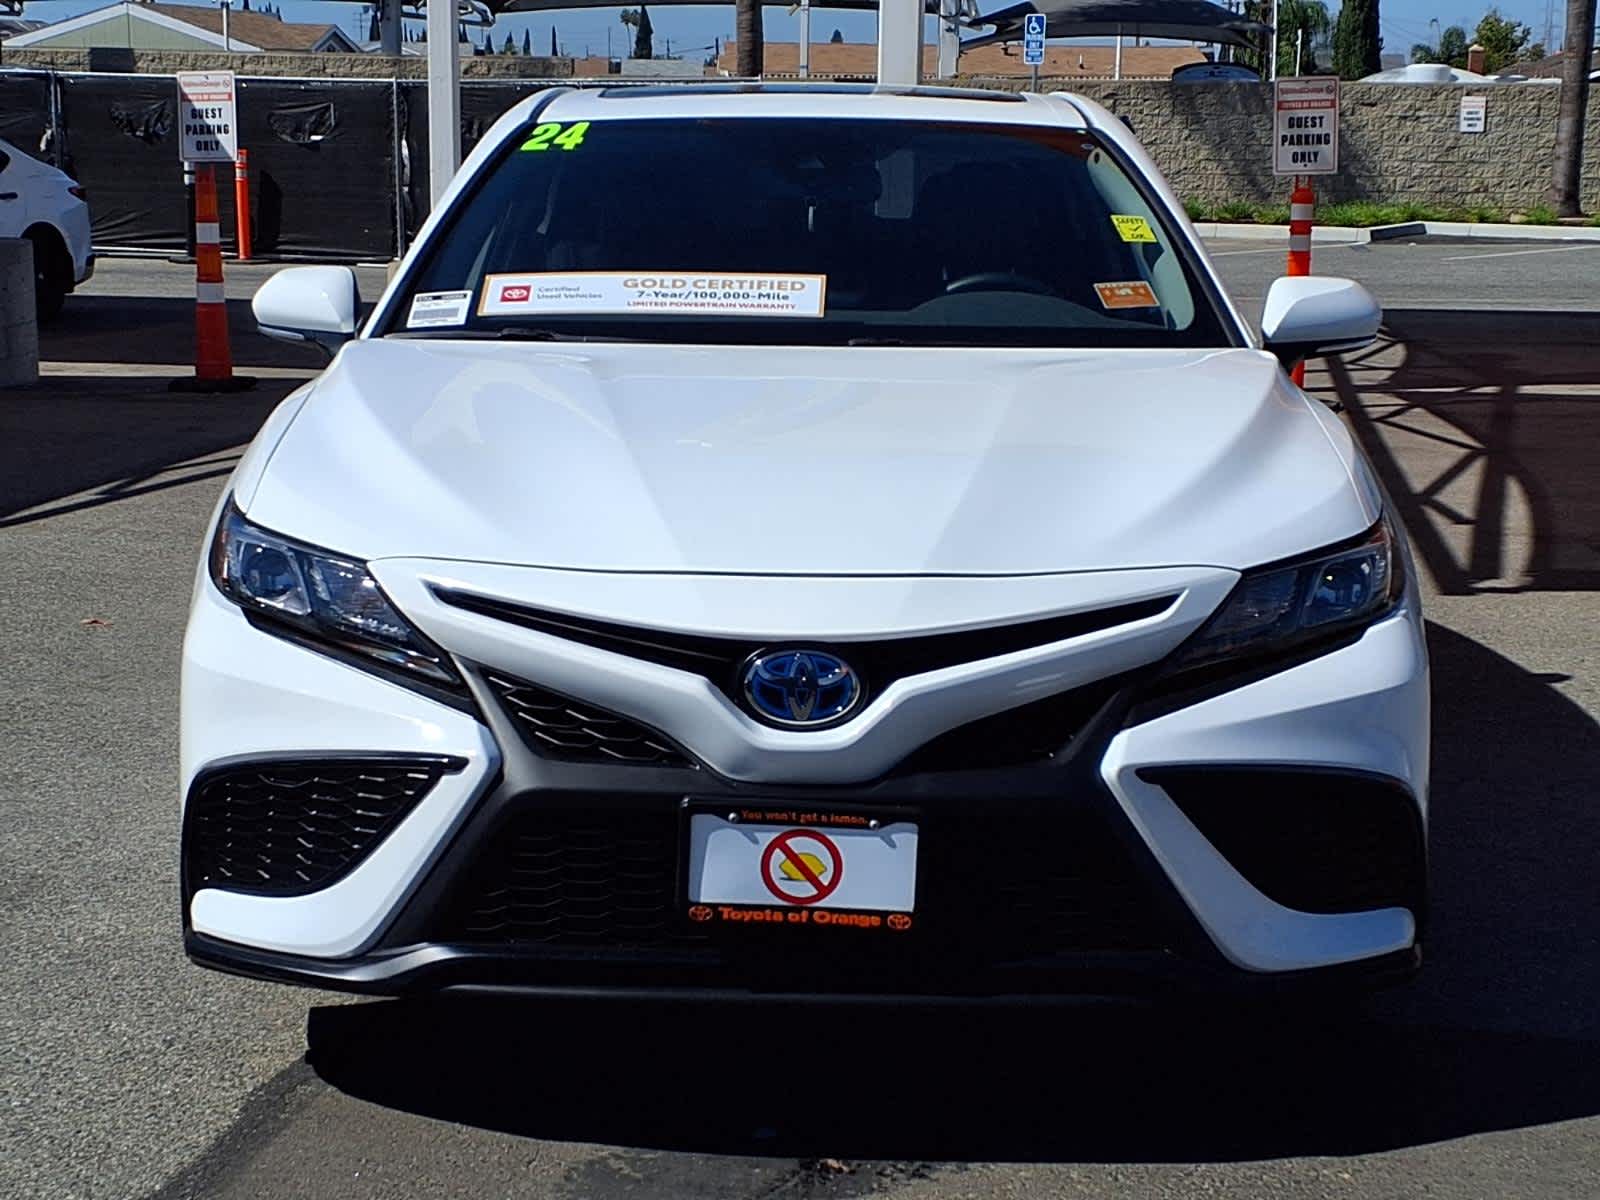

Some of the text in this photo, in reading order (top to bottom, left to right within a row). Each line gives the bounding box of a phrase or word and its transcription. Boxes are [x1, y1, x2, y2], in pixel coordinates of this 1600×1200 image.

[190, 107, 222, 119] GUEST
[1288, 116, 1325, 128] GUEST
[185, 124, 230, 136] PARKING
[520, 121, 590, 151] 24
[195, 140, 221, 151] ONLY
[1281, 133, 1331, 147] PARKING
[1292, 151, 1320, 163] ONLY
[623, 278, 806, 292] GOLD CERTIFIED
[636, 290, 791, 301] 7-Year/100,000-Mile
[626, 300, 796, 310] LIMITED POWERTRAIN WARRANTY
[741, 809, 762, 820] You
[718, 906, 881, 927] Toyota of Orange
